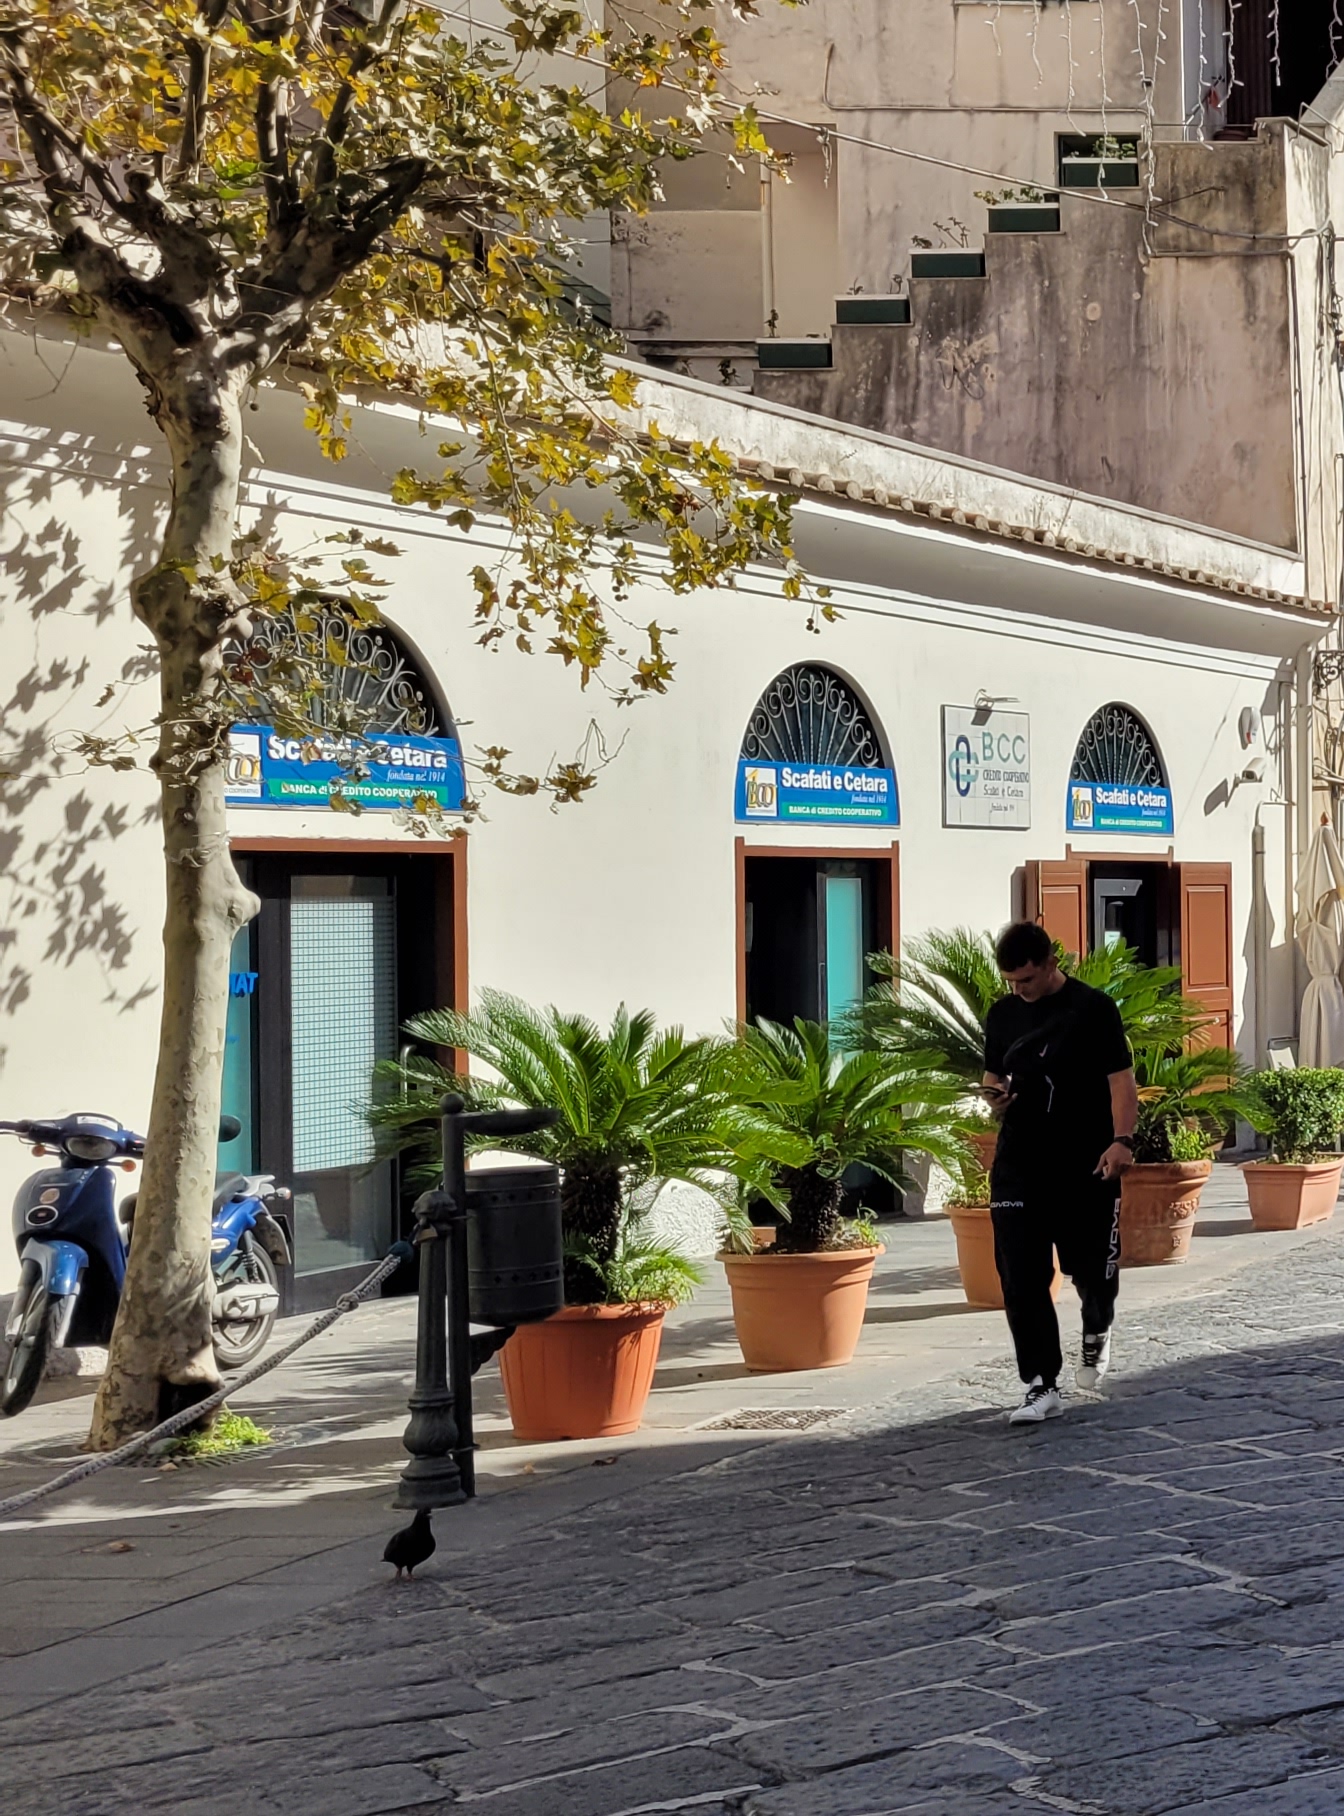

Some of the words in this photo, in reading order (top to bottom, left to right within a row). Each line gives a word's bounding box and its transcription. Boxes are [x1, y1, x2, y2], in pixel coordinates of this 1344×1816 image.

[267, 735, 352, 762] Scfati
[982, 731, 1026, 764] BCC
[428, 771, 446, 782] 1914
[782, 767, 831, 789] Scafati
[833, 775, 842, 790] e
[844, 771, 888, 792] Cetara
[372, 787, 437, 799] COOPERAVO
[1096, 786, 1129, 806] Scafati
[1130, 794, 1136, 806] e
[1137, 789, 1167, 807] Cetara
[789, 805, 810, 814] BANCA
[817, 806, 842, 816] CREDITO
[843, 807, 882, 817] COOPERATIVO
